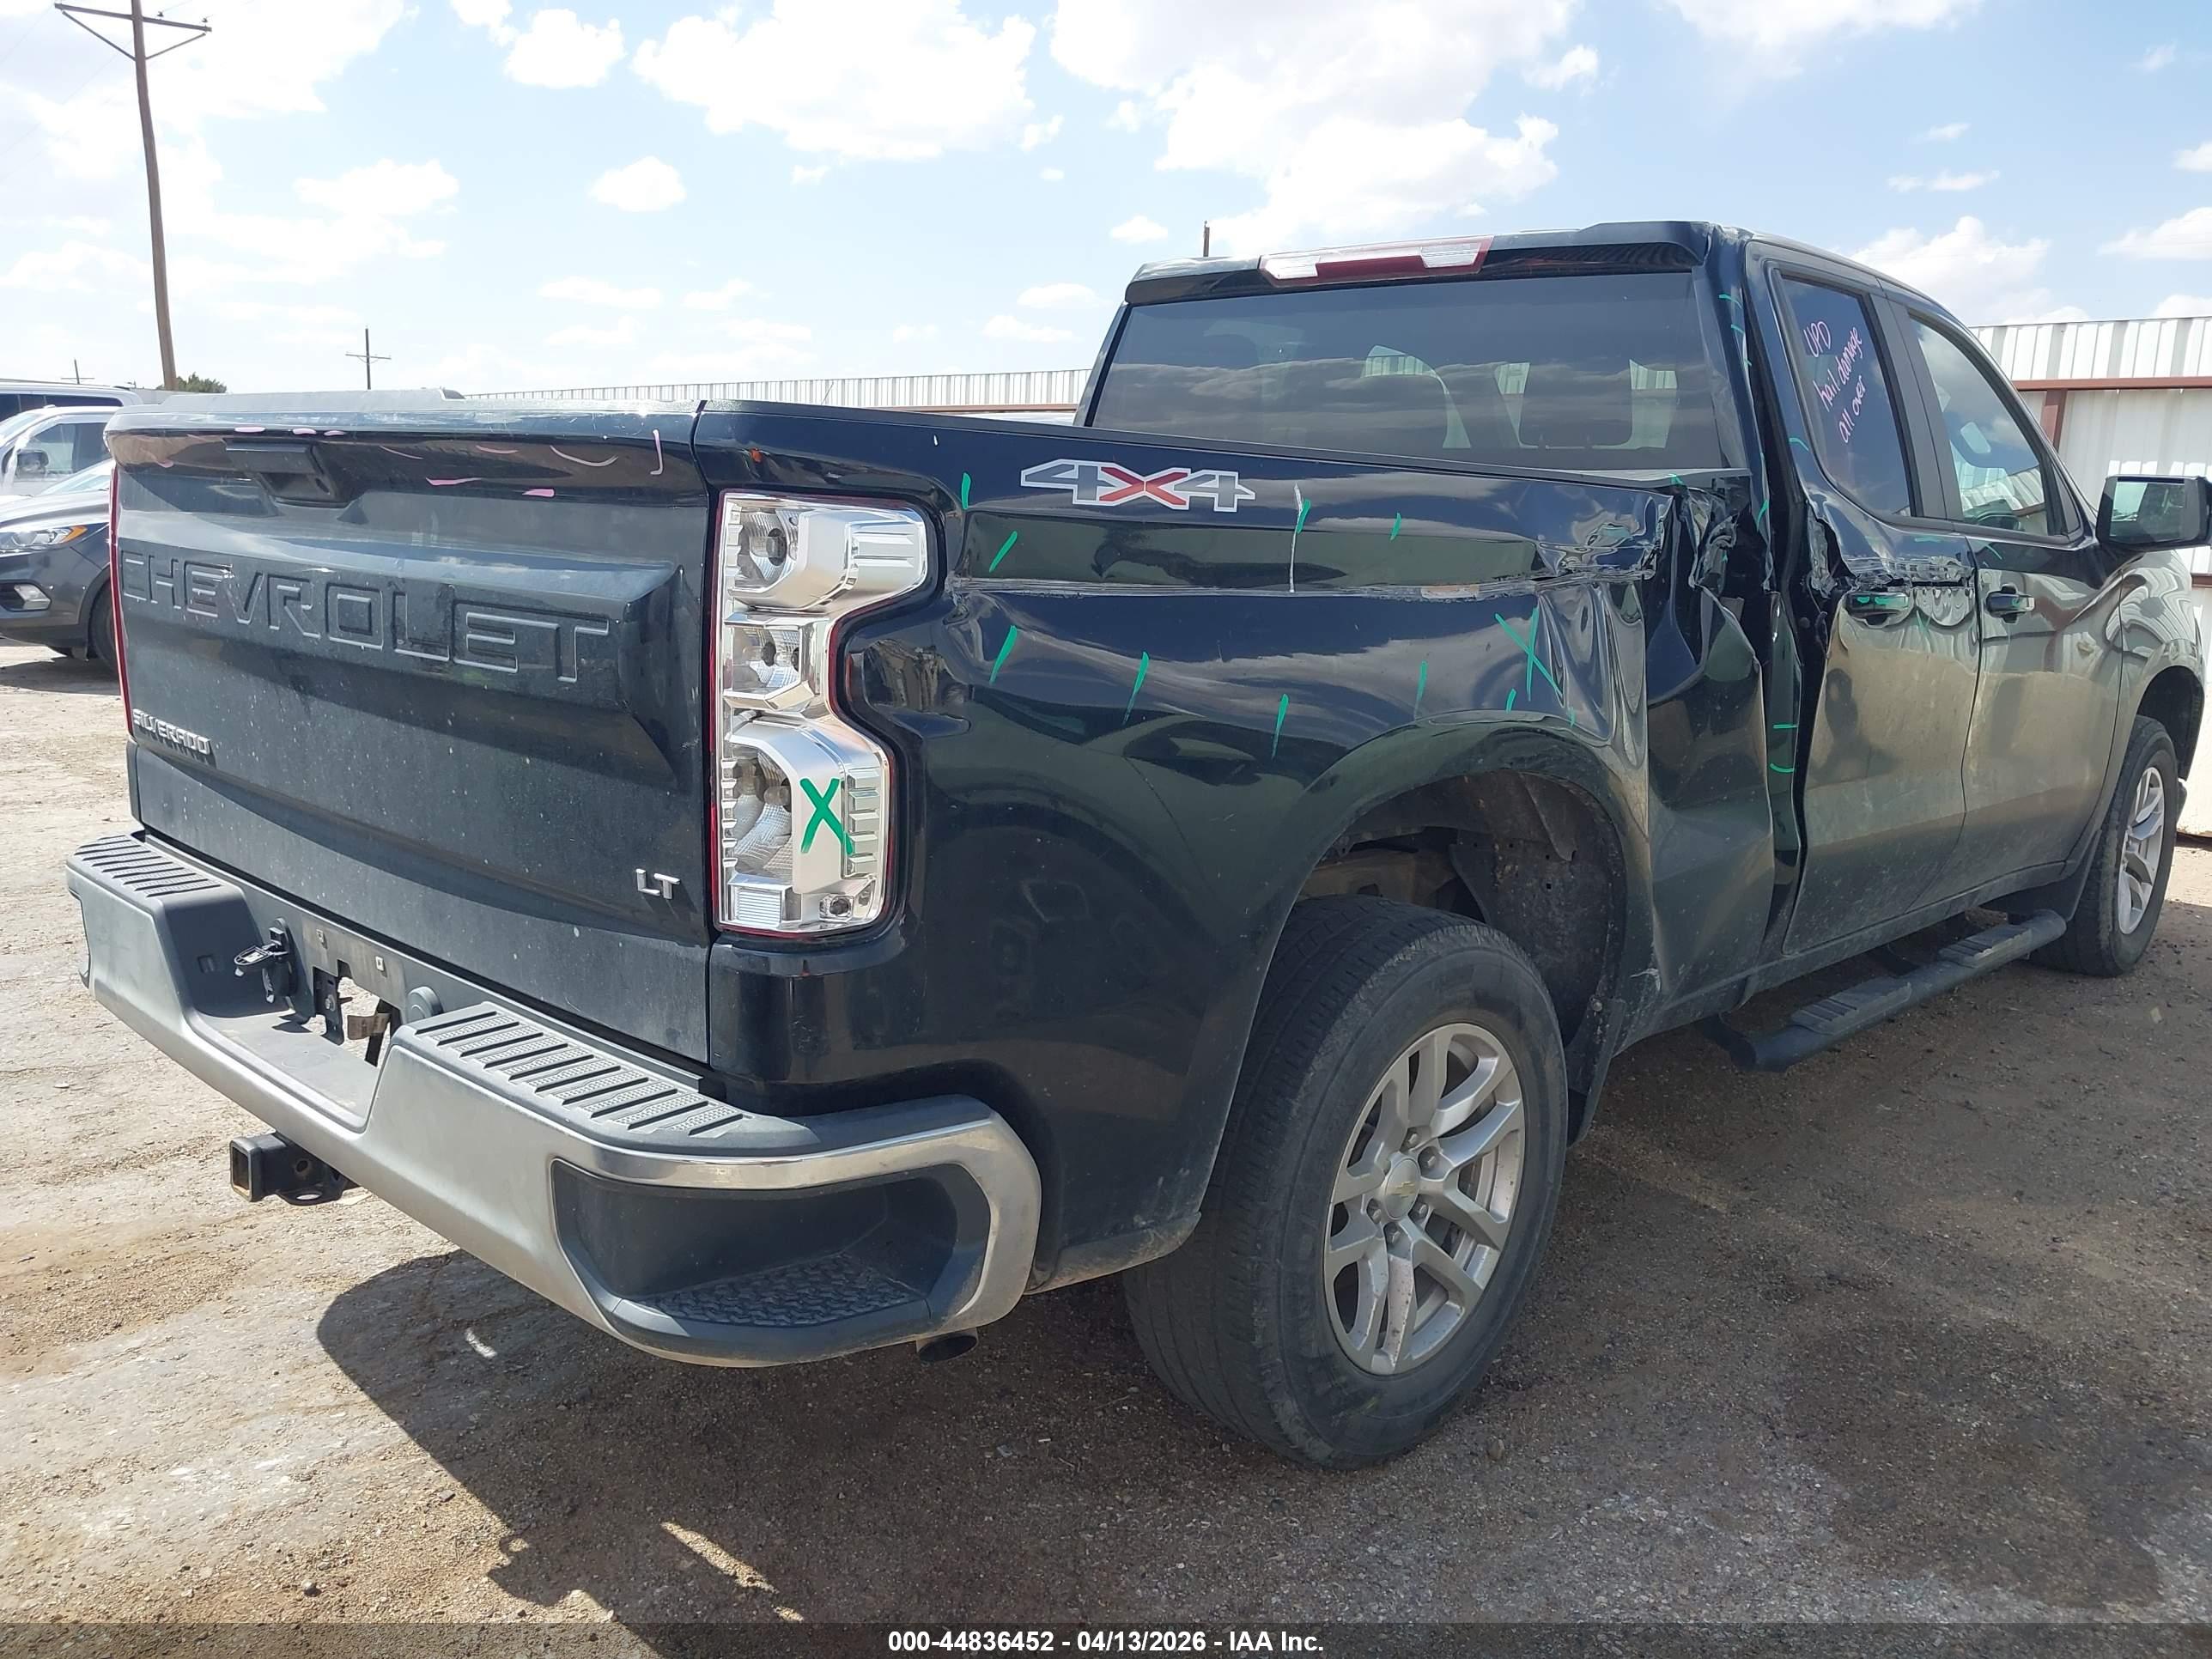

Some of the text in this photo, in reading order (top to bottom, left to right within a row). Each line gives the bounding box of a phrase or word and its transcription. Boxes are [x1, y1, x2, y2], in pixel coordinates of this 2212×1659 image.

[1813, 326, 1863, 412] hail damage
[1839, 375, 1866, 443] all over
[119, 550, 610, 684] CHEVROLET
[132, 708, 211, 755] SILVERADO
[635, 868, 681, 900] LT
